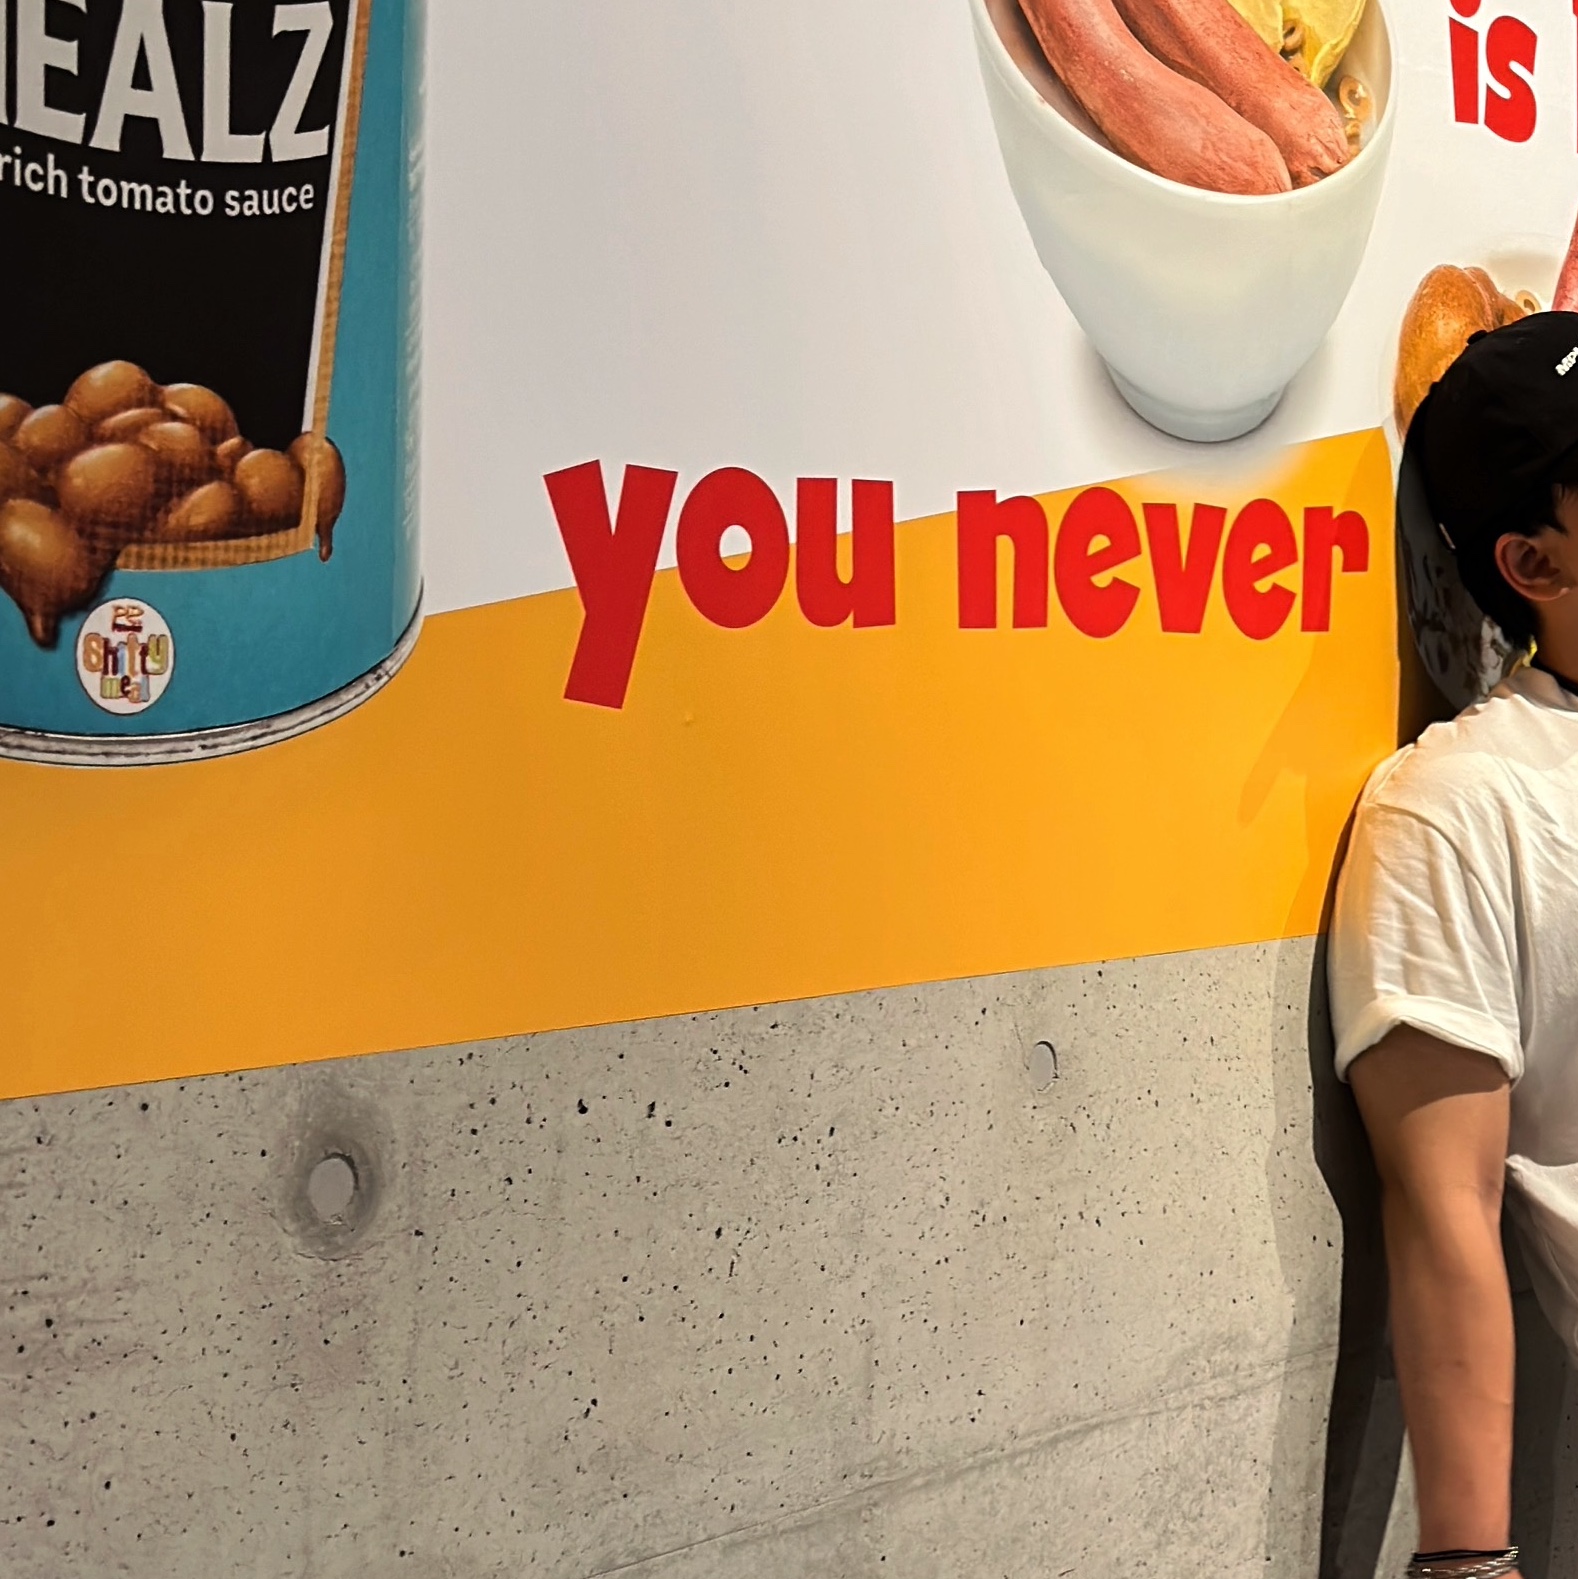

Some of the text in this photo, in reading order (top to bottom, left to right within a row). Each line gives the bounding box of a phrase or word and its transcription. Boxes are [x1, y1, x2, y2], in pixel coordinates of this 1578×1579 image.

[0, 0, 333, 163] EALZ
[1449, 0, 1537, 142] is
[0, 146, 315, 217] rich tomato sauce
[543, 459, 896, 710] you
[956, 486, 1370, 641] never
